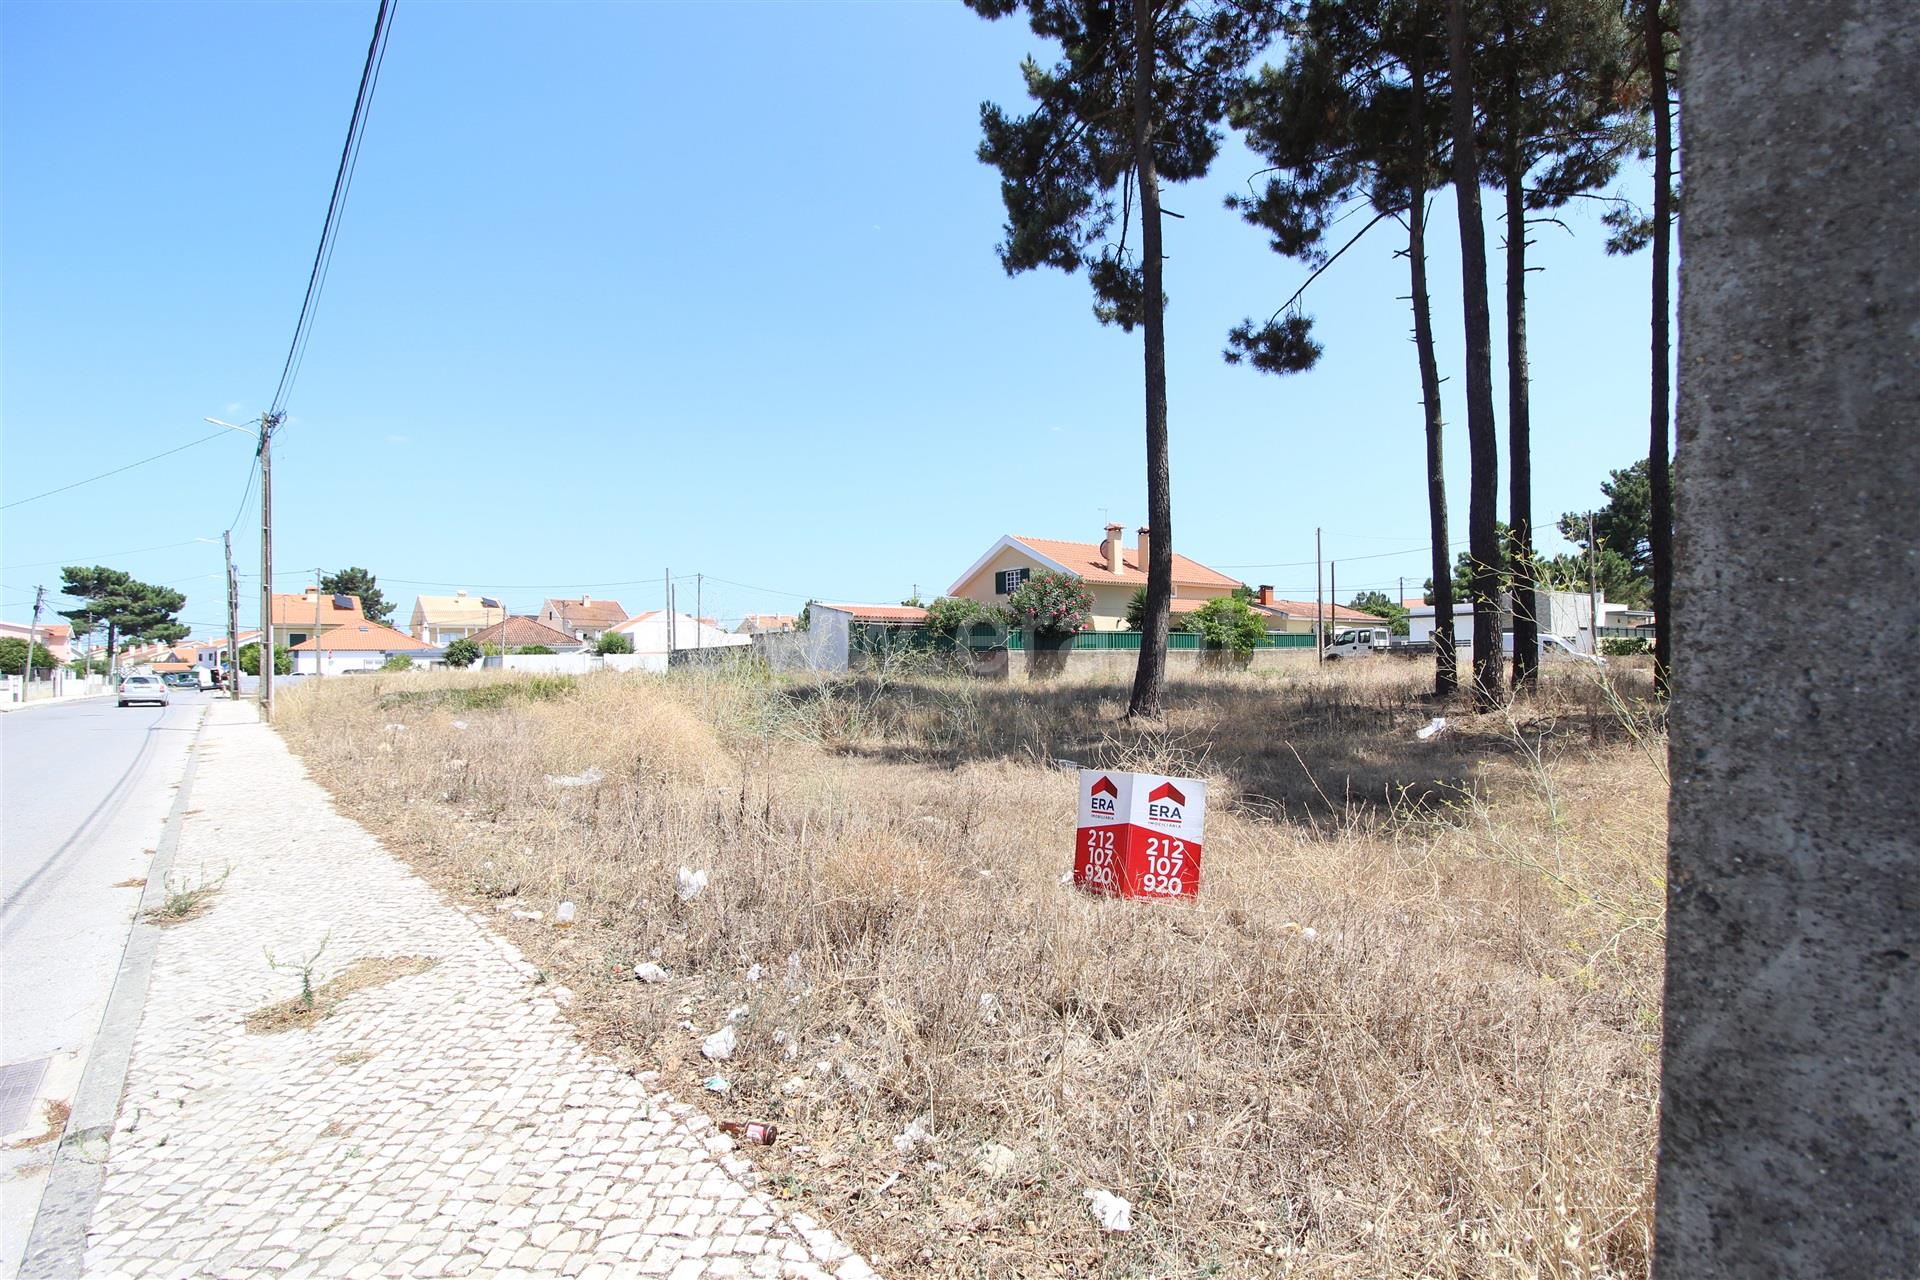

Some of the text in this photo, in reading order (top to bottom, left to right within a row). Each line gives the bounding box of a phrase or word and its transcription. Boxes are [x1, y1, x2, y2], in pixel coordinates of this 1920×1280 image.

[1091, 797, 1115, 811] ERA
[1149, 804, 1182, 819] ERA
[1087, 829, 1114, 849] 212
[1146, 837, 1184, 859] 212
[1088, 847, 1113, 866] 107
[1147, 856, 1183, 876] 107
[1085, 863, 1111, 885] 920
[1143, 873, 1182, 895] 920
